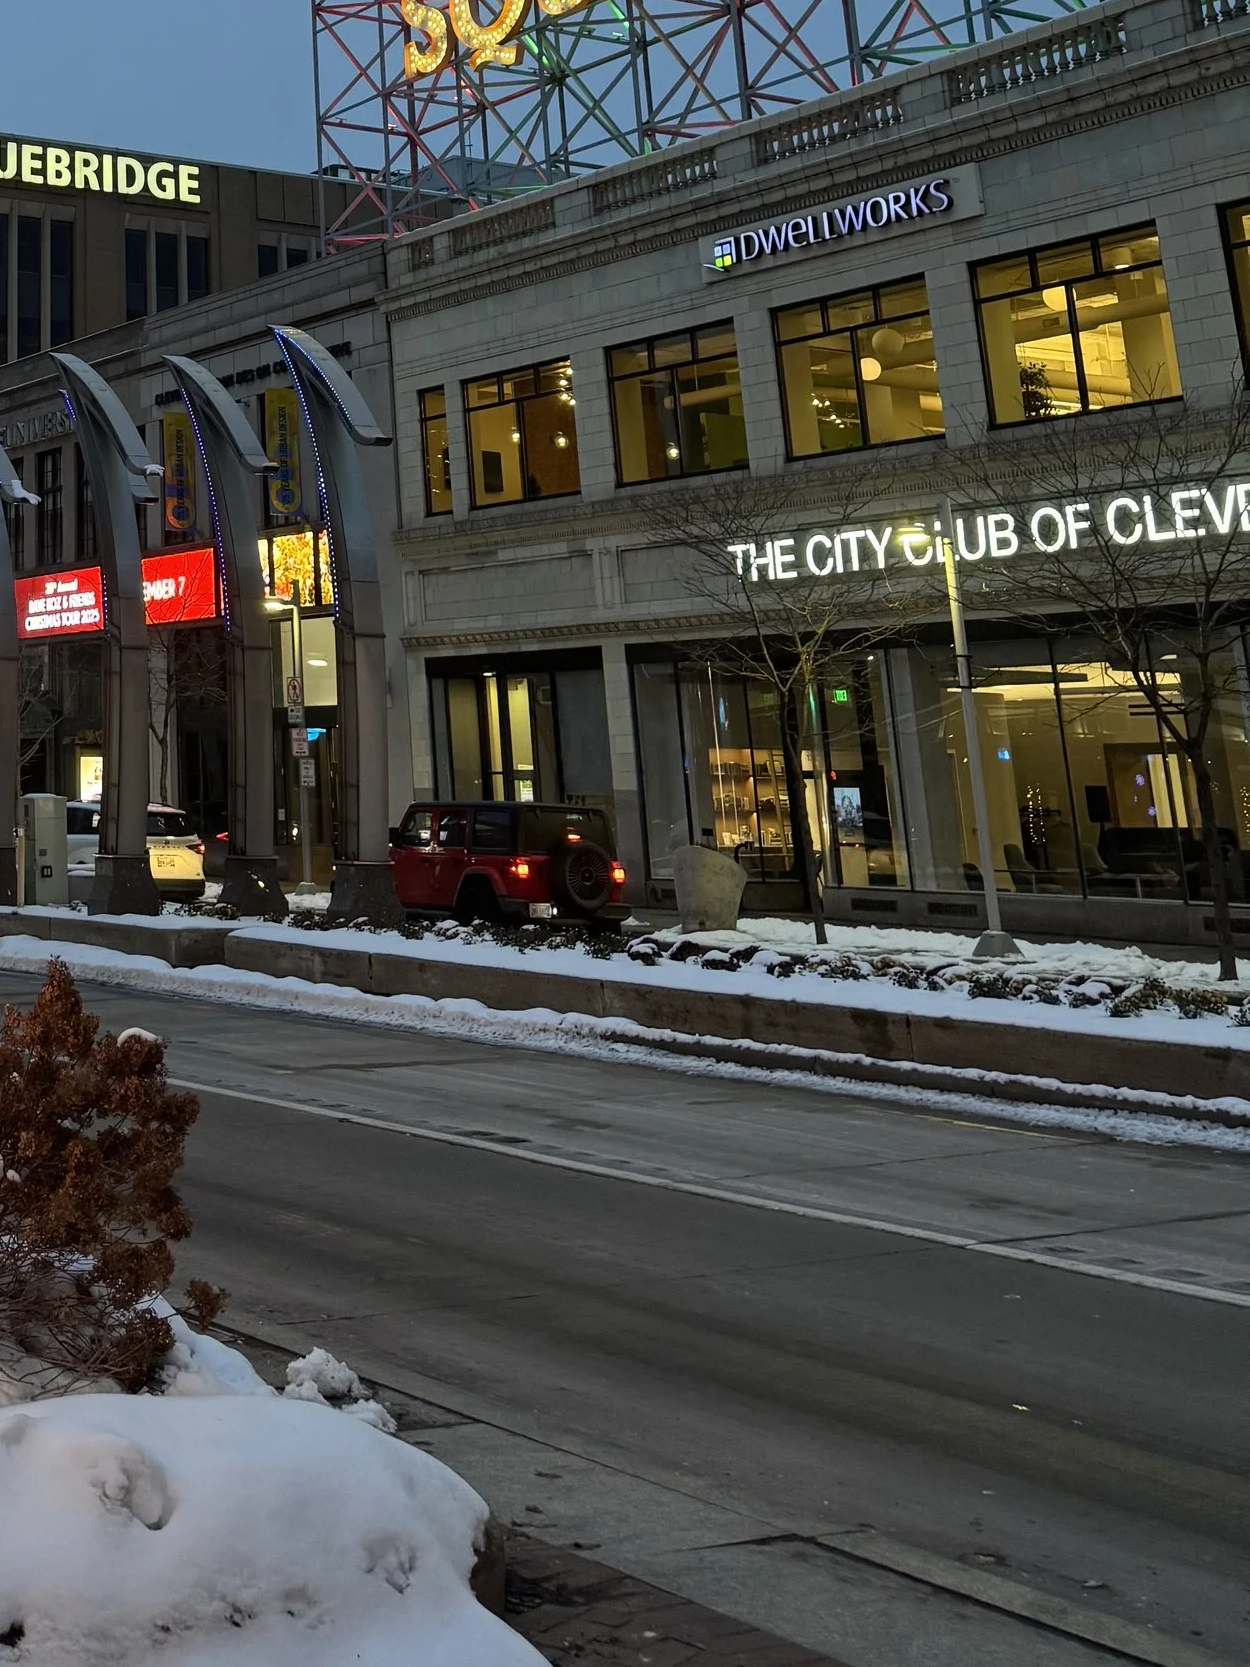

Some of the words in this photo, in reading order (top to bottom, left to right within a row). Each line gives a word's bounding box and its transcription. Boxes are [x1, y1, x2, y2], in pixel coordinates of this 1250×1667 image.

[727, 538, 798, 582] THE
[806, 526, 892, 576] CITY
[1031, 502, 1090, 553] OF
[178, 576, 187, 597] 7
